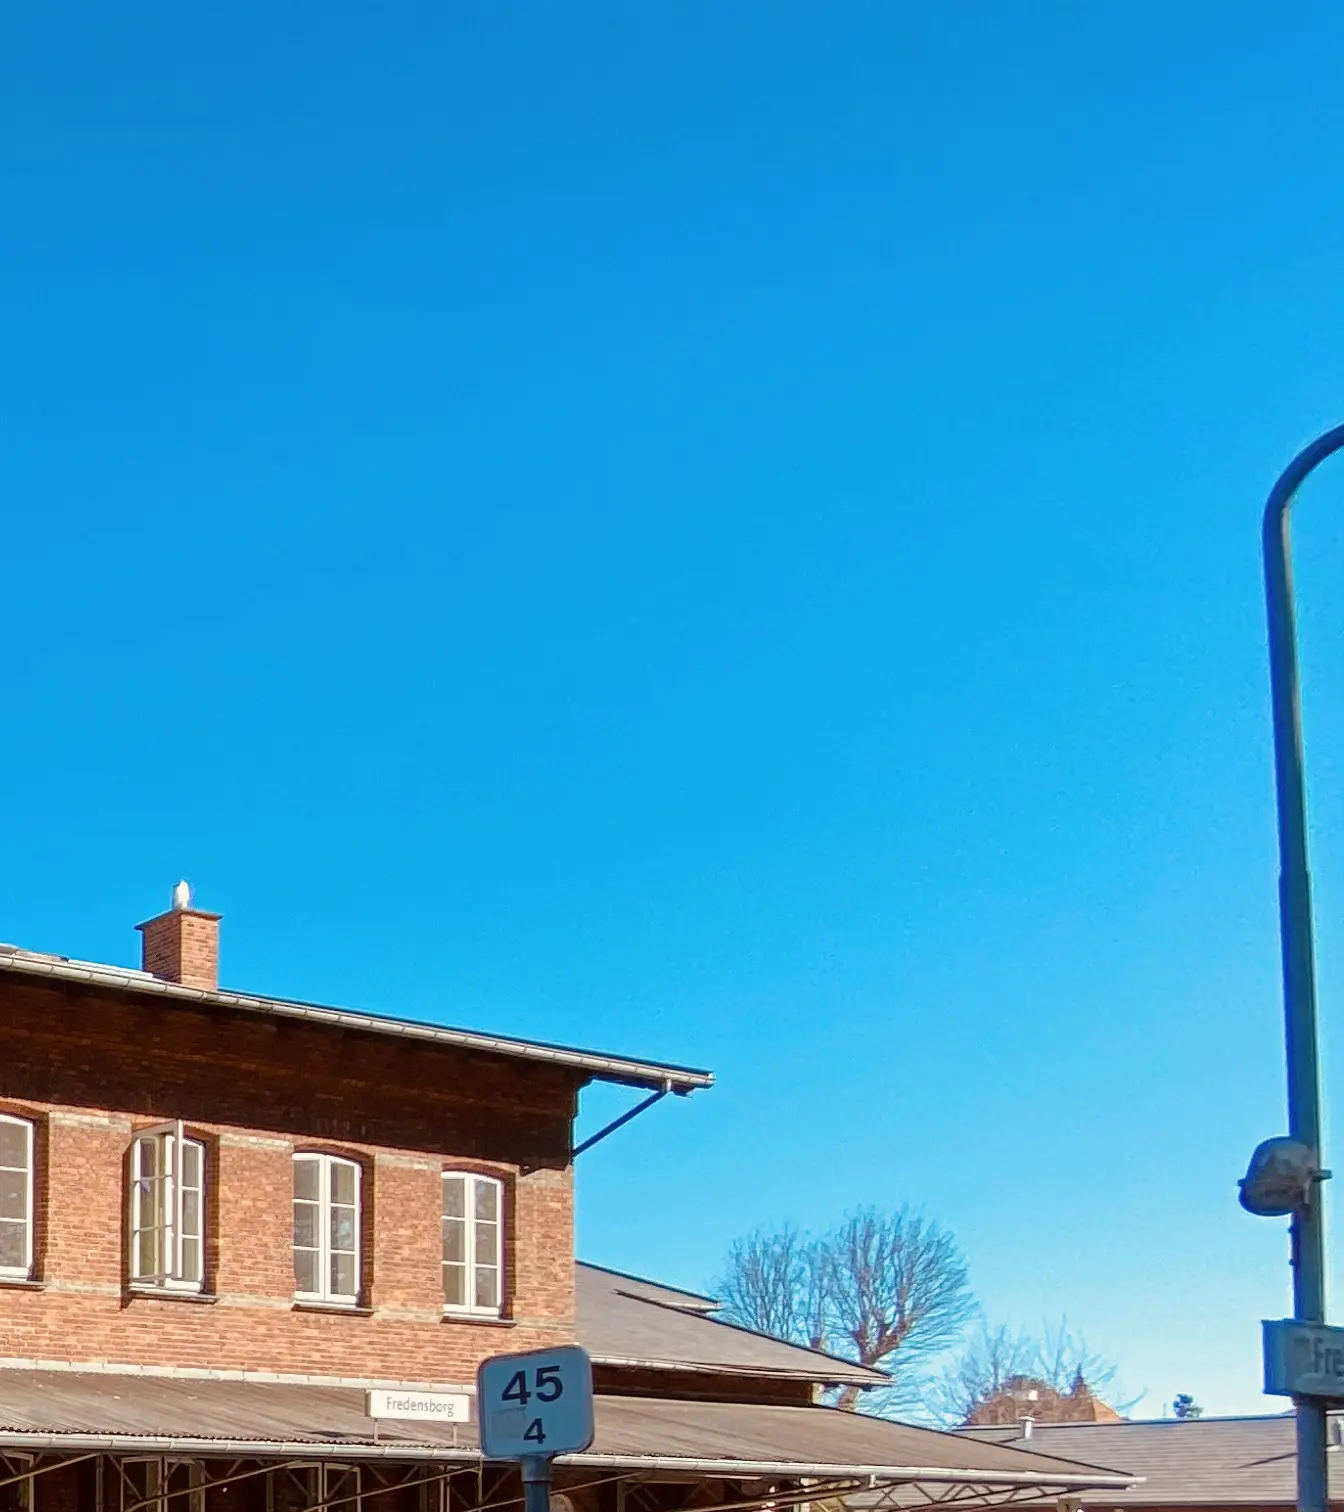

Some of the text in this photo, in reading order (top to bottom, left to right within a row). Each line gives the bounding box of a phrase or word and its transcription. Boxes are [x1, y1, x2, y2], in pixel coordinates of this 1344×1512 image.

[502, 1364, 563, 1405] 45
[386, 1396, 454, 1417] Fredensborg
[524, 1418, 547, 1444] 4
